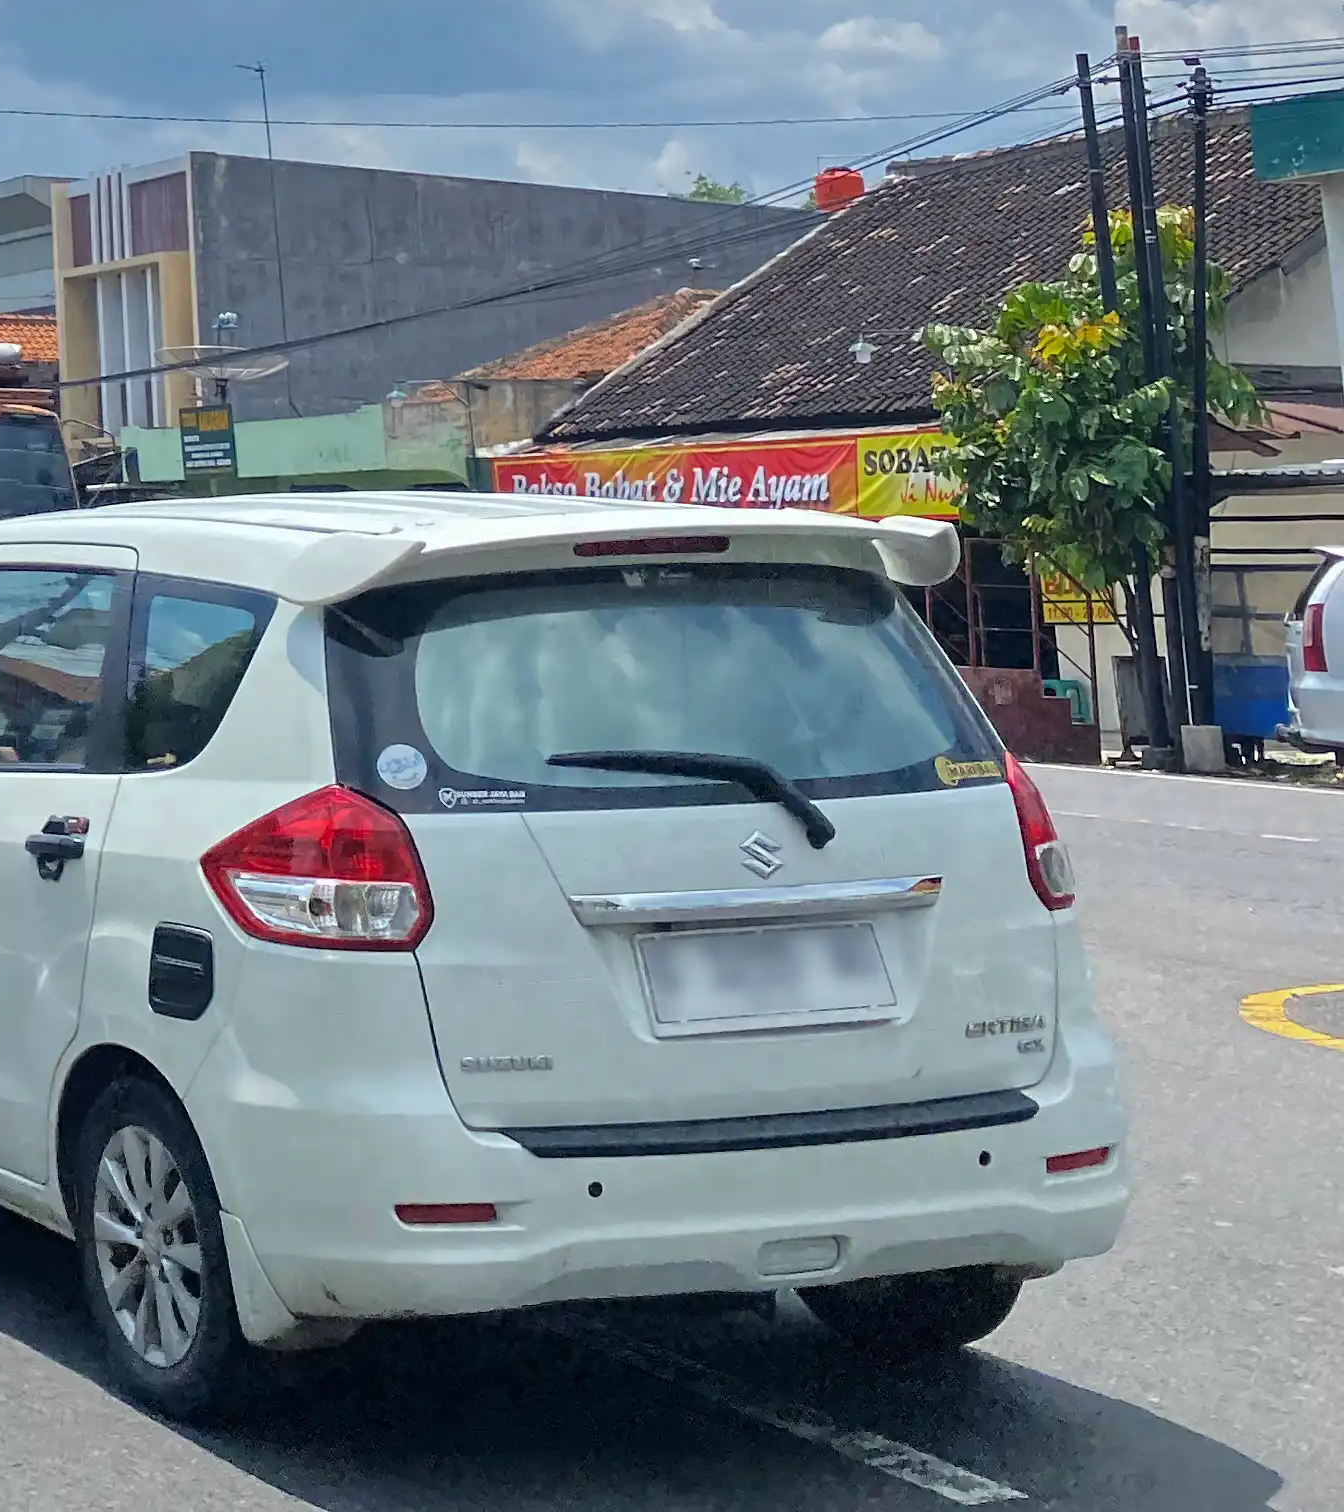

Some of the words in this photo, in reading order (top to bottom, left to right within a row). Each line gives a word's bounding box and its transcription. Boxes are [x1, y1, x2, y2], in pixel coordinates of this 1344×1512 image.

[663, 468, 685, 503] &
[690, 466, 742, 503] Mie
[745, 465, 830, 509] Ayam
[460, 1054, 553, 1073] SUZUKI
